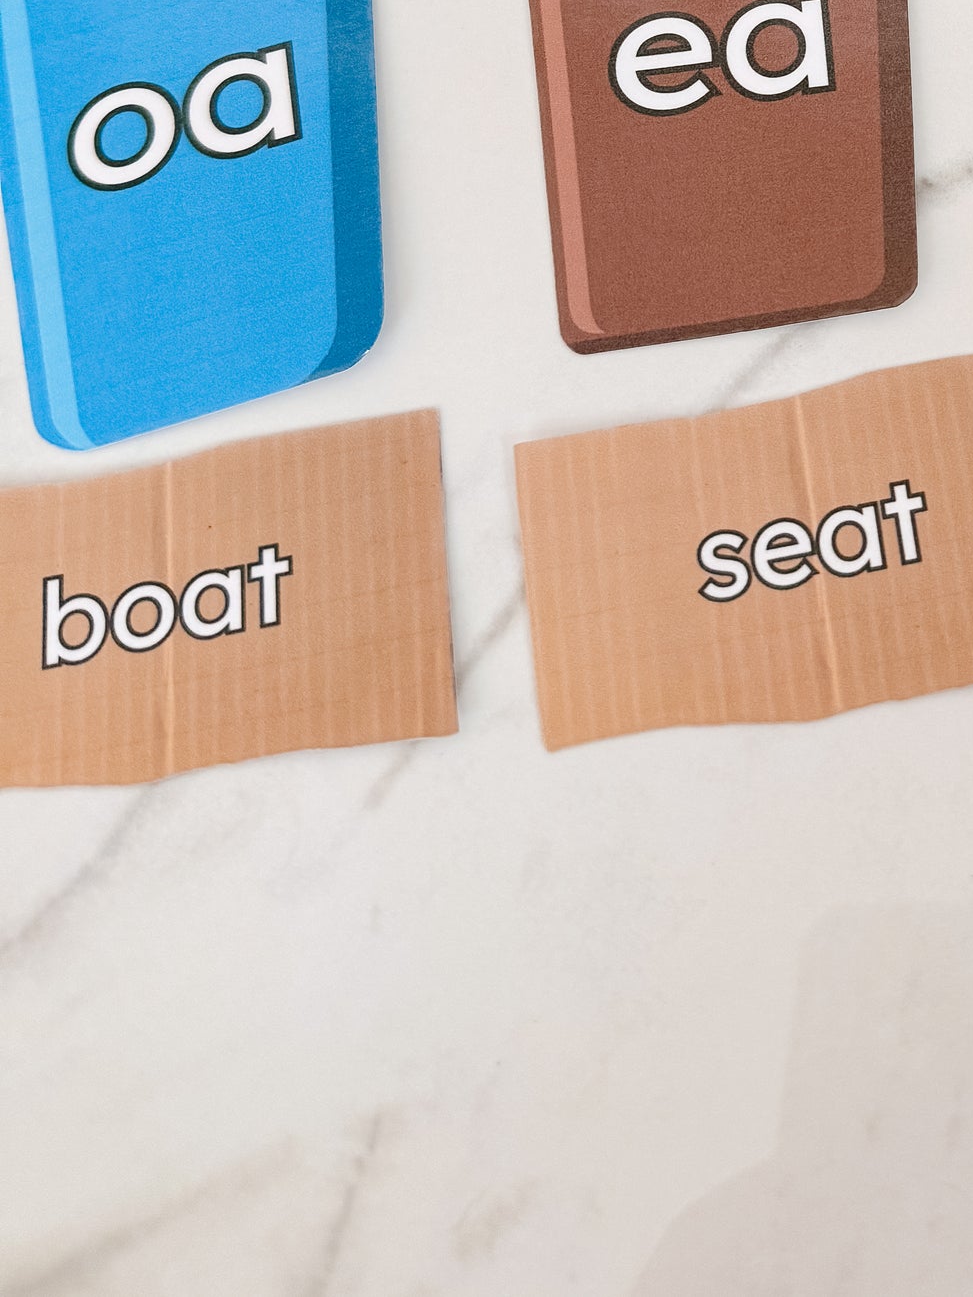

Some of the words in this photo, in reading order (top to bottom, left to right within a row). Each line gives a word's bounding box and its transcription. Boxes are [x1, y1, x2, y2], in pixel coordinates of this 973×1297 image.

[67, 40, 302, 191] oa
[697, 479, 928, 602] seat
[42, 543, 293, 670] boat
